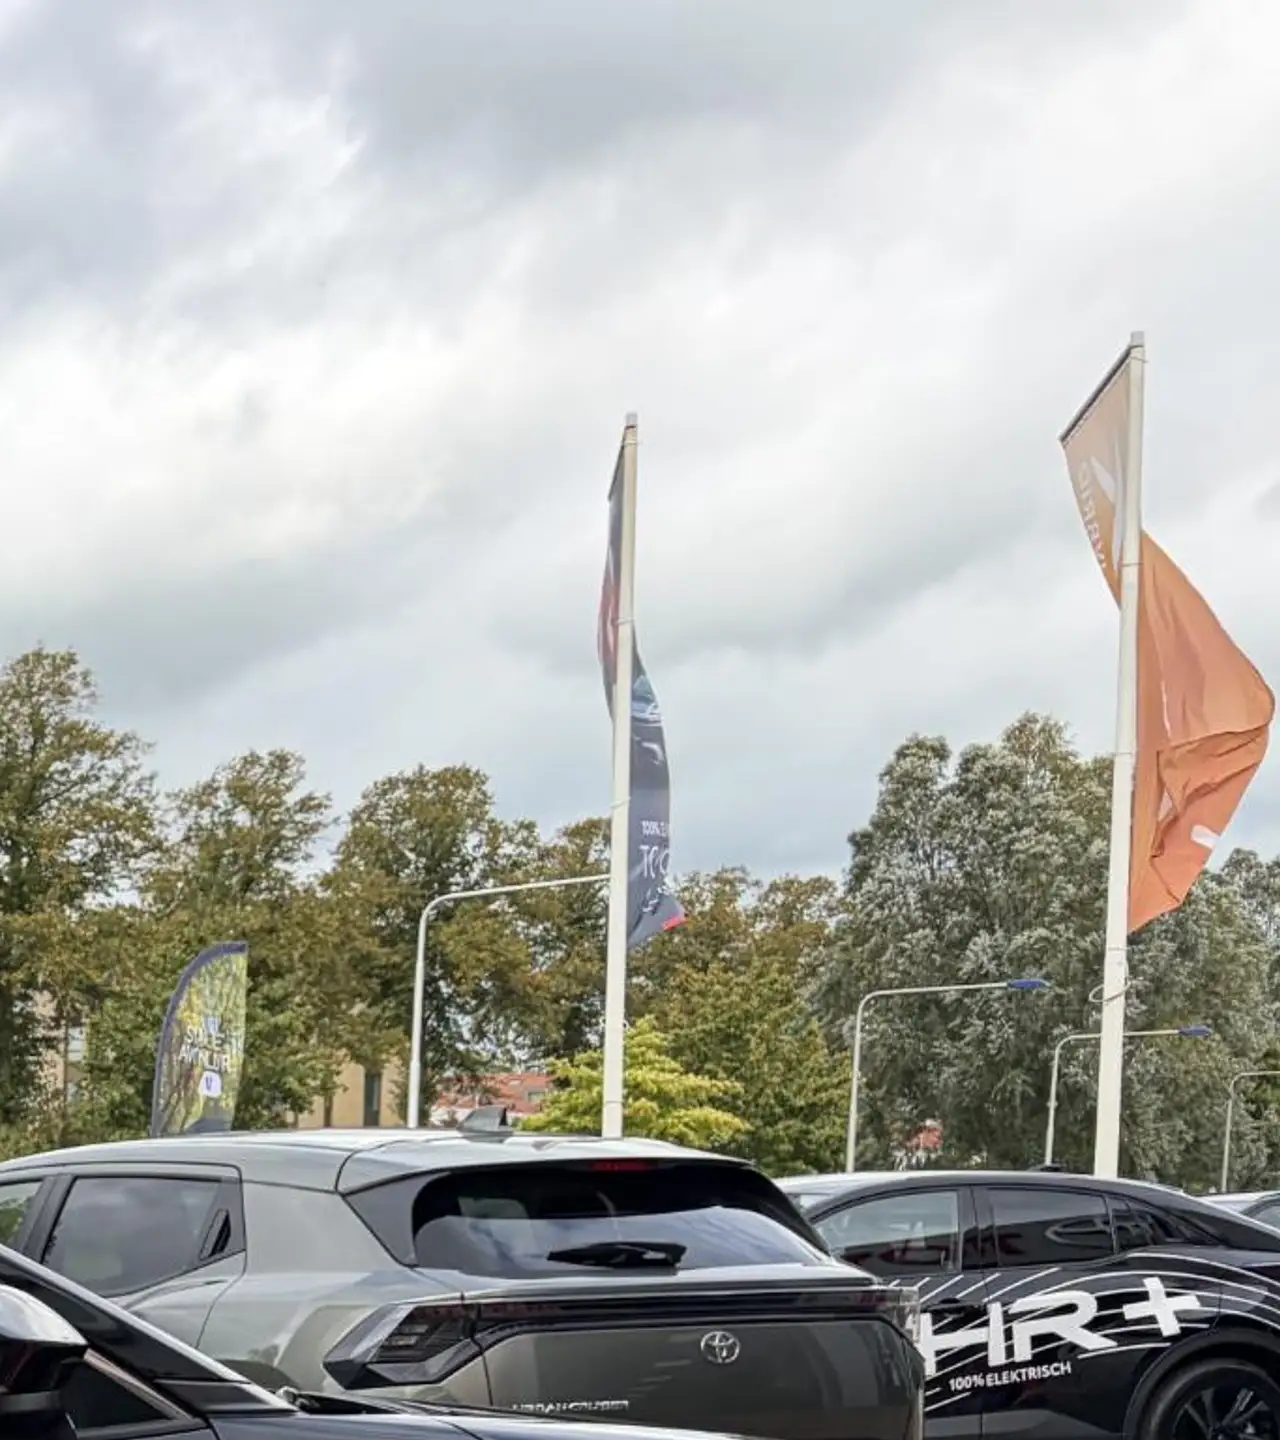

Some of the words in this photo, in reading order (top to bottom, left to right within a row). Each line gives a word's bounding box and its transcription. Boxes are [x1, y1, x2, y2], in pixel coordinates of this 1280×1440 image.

[916, 1276, 1202, 1377] HR+
[948, 1373, 984, 1391] 100%
[985, 1360, 1072, 1388] ELEKTRISCH
